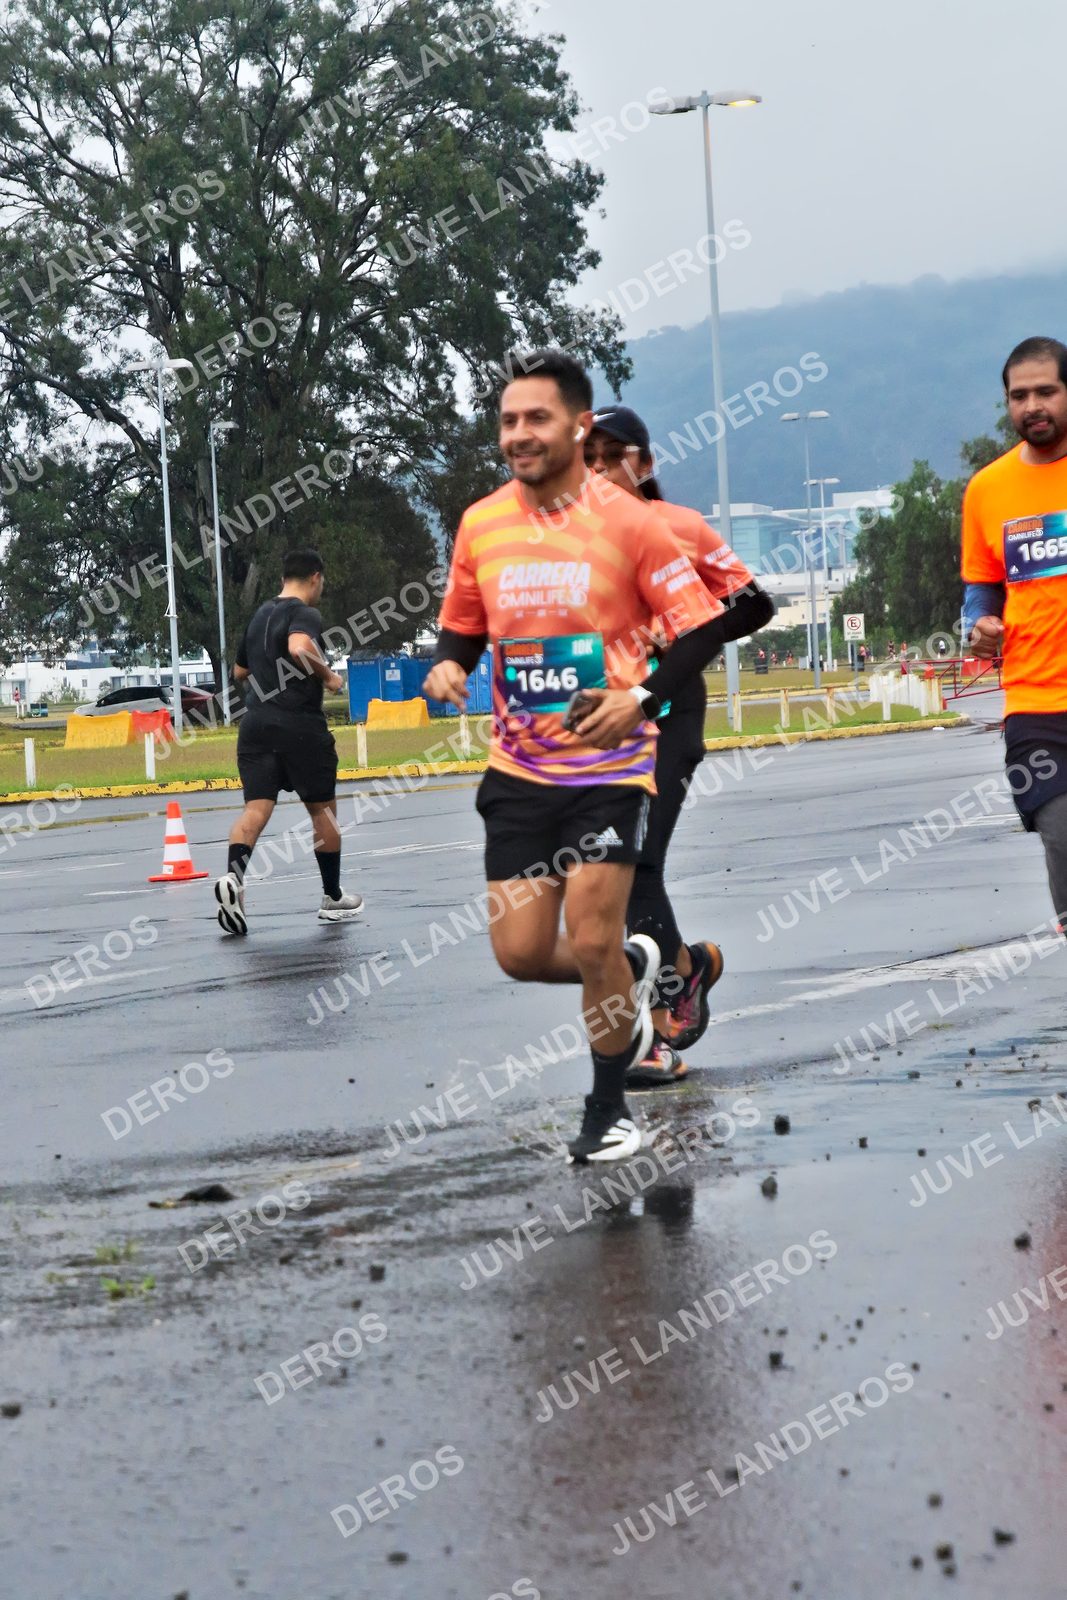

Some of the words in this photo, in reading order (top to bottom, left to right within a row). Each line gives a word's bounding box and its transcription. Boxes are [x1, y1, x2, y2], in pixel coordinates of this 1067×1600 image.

[1018, 536, 1067, 562] 1665
[500, 561, 591, 590] CARRERA
[572, 638, 593, 656] 10K
[517, 666, 579, 692] 1646
